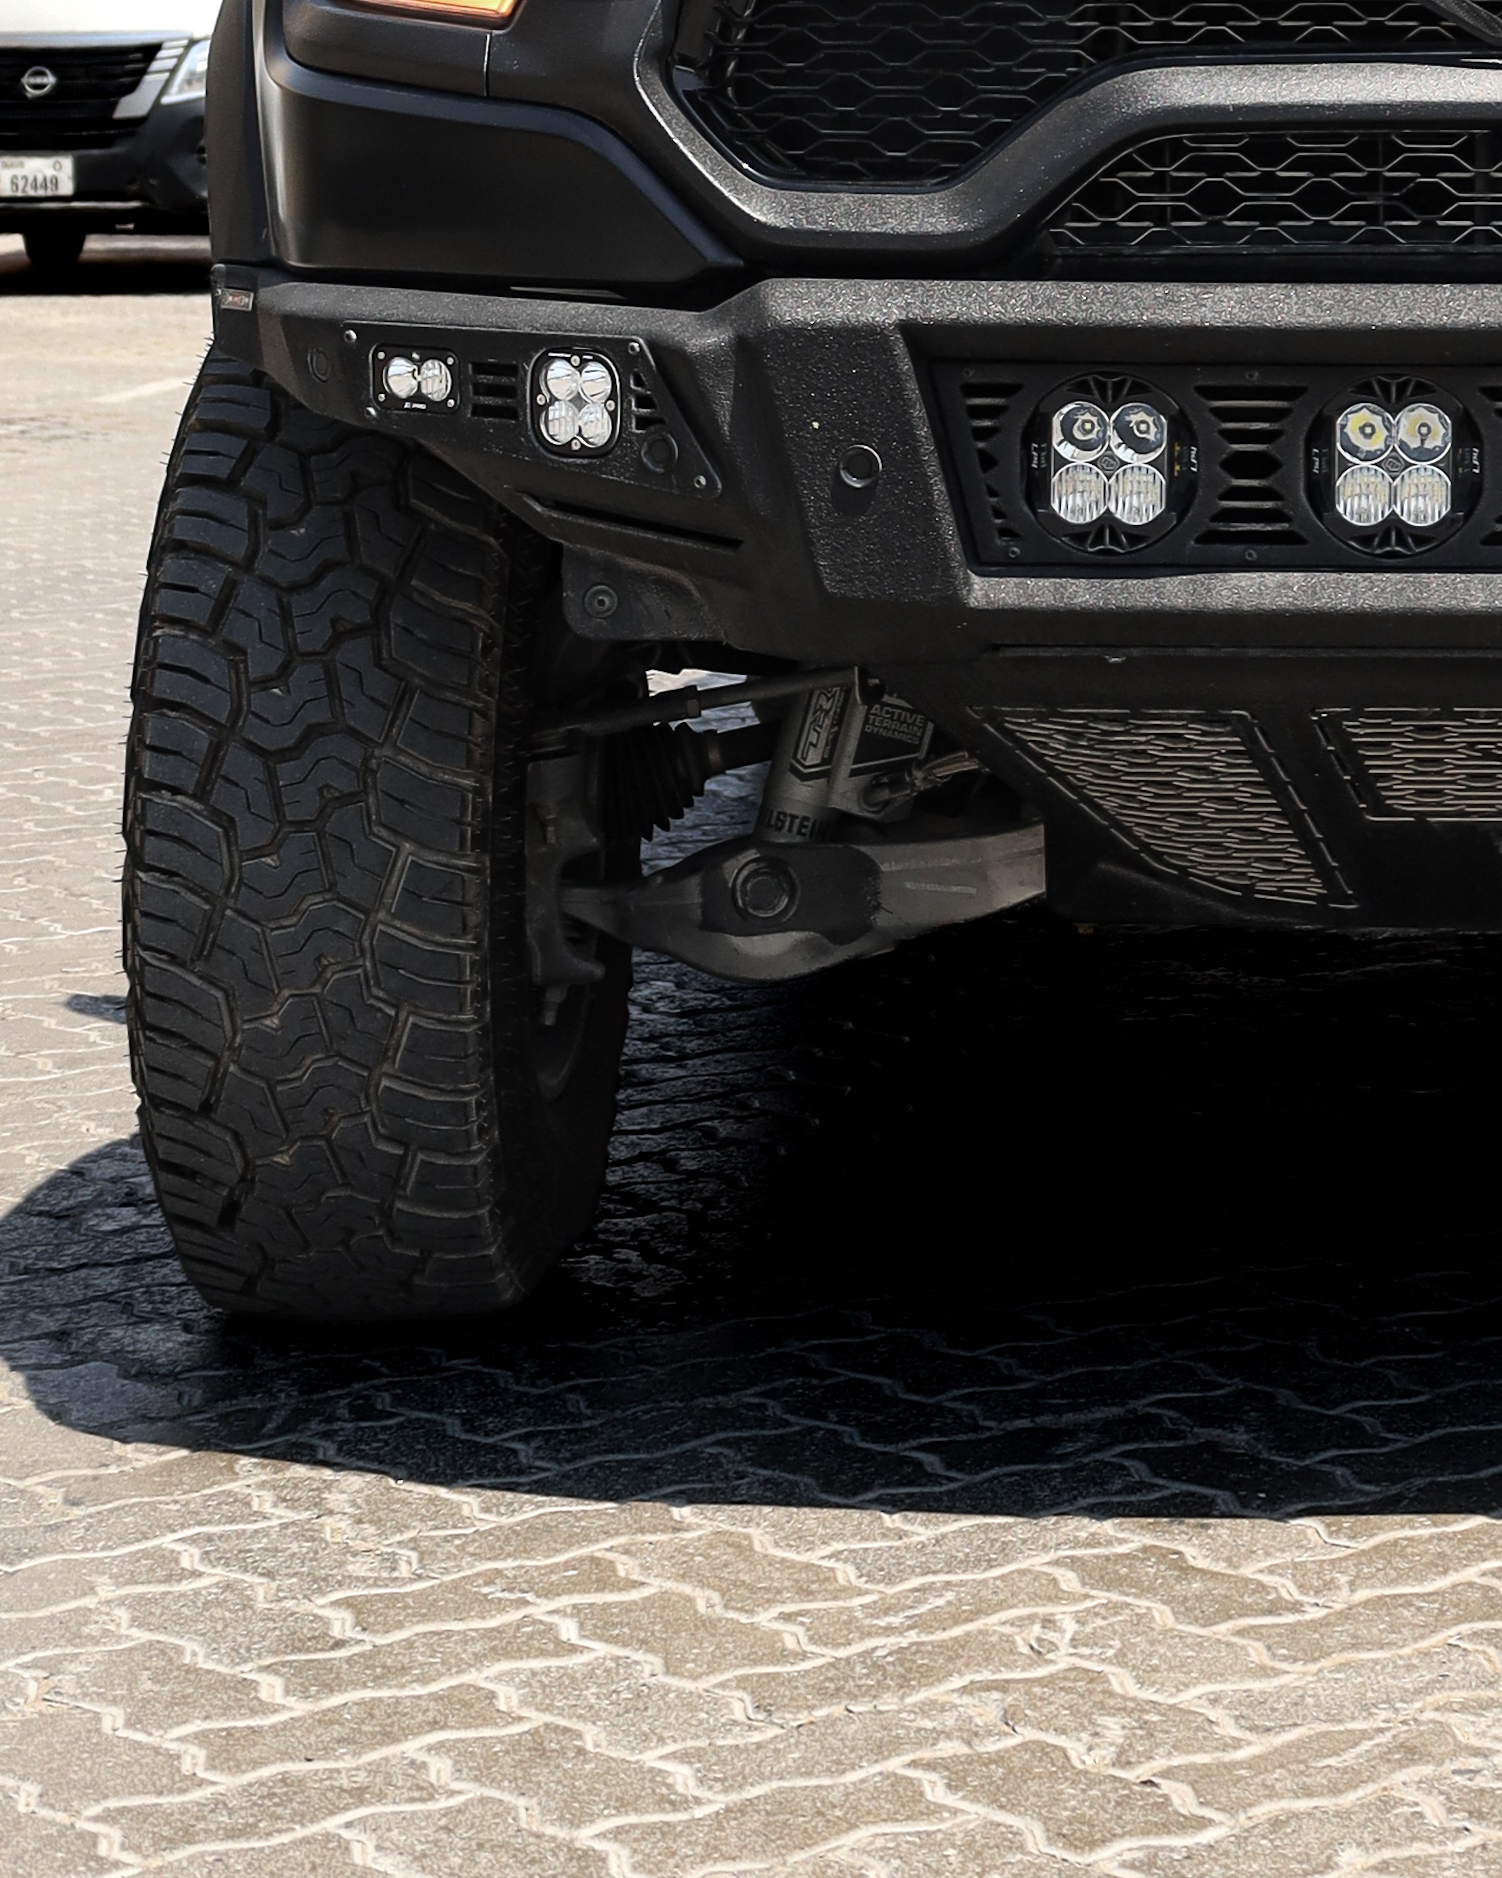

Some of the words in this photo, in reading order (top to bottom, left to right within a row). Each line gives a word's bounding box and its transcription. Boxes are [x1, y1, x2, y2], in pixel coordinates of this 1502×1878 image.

[10, 174, 59, 194] 62449
[802, 688, 839, 760] TR
[868, 715, 924, 737] TERRAIN
[870, 704, 925, 727] ACTIVE
[865, 724, 920, 745] DYNAMICS
